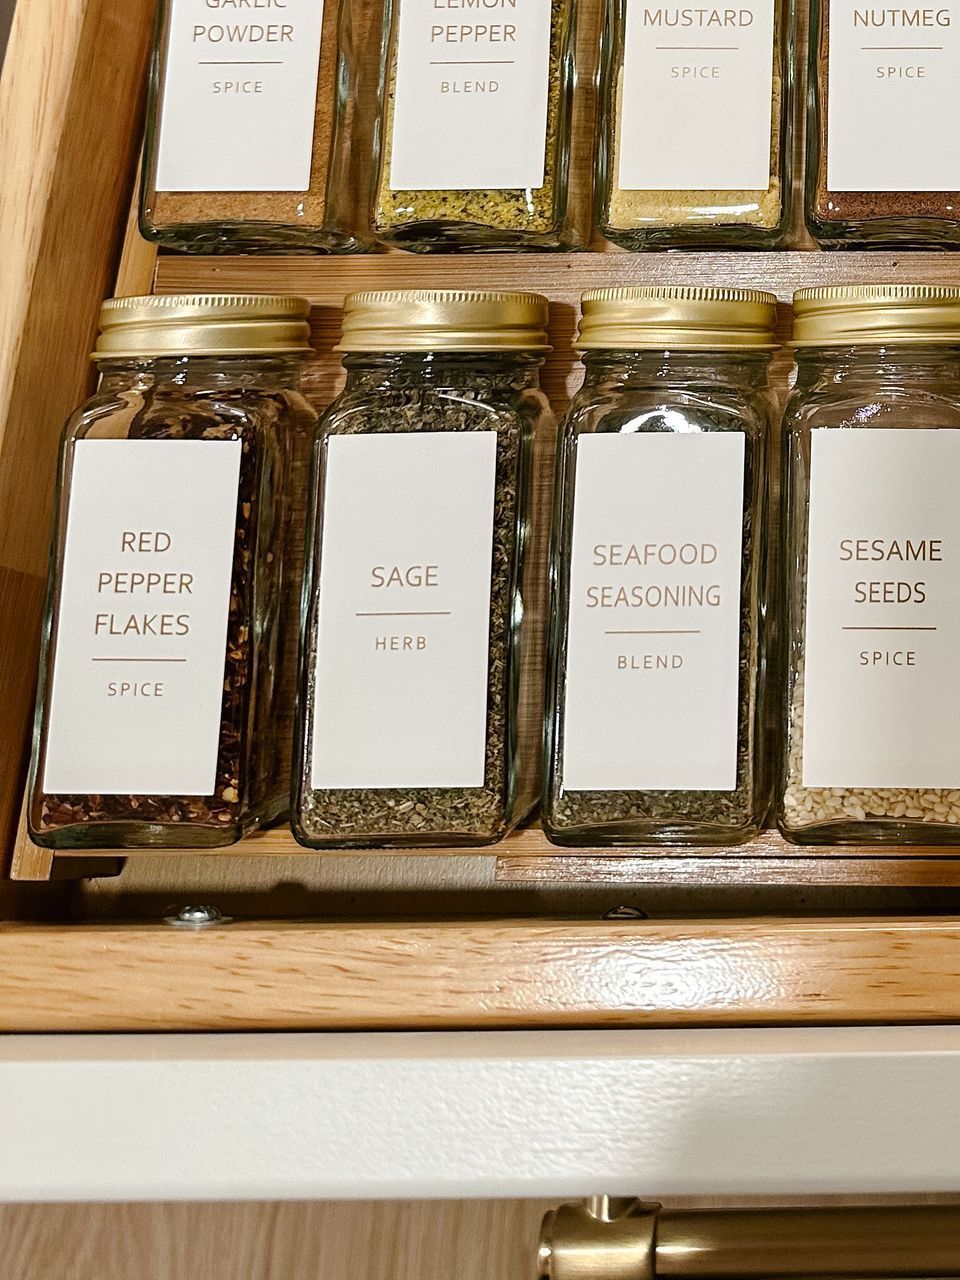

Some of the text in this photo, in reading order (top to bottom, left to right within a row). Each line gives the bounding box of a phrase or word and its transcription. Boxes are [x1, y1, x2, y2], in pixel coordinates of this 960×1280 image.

[643, 8, 754, 27] MUSTARD
[853, 8, 951, 28] NUTMEG
[192, 24, 294, 44] POWDER
[429, 24, 517, 43] PEPPER
[670, 66, 721, 80] SPICE
[876, 66, 926, 79] SPICE
[211, 80, 263, 94] SPICE
[439, 80, 499, 94] BLEND
[121, 531, 172, 553] RED
[839, 539, 943, 562] SESAME
[592, 542, 718, 567] SEAFOOD
[97, 572, 194, 595] PEPPER
[370, 565, 440, 589] SAGE
[585, 584, 721, 609] SEASONING
[854, 581, 926, 604] SEEDS
[94, 613, 191, 637] FLAKES
[375, 635, 427, 651] HERB
[617, 654, 684, 670] BLEND
[859, 650, 916, 667] SPICE
[104, 680, 164, 698] SPICE
